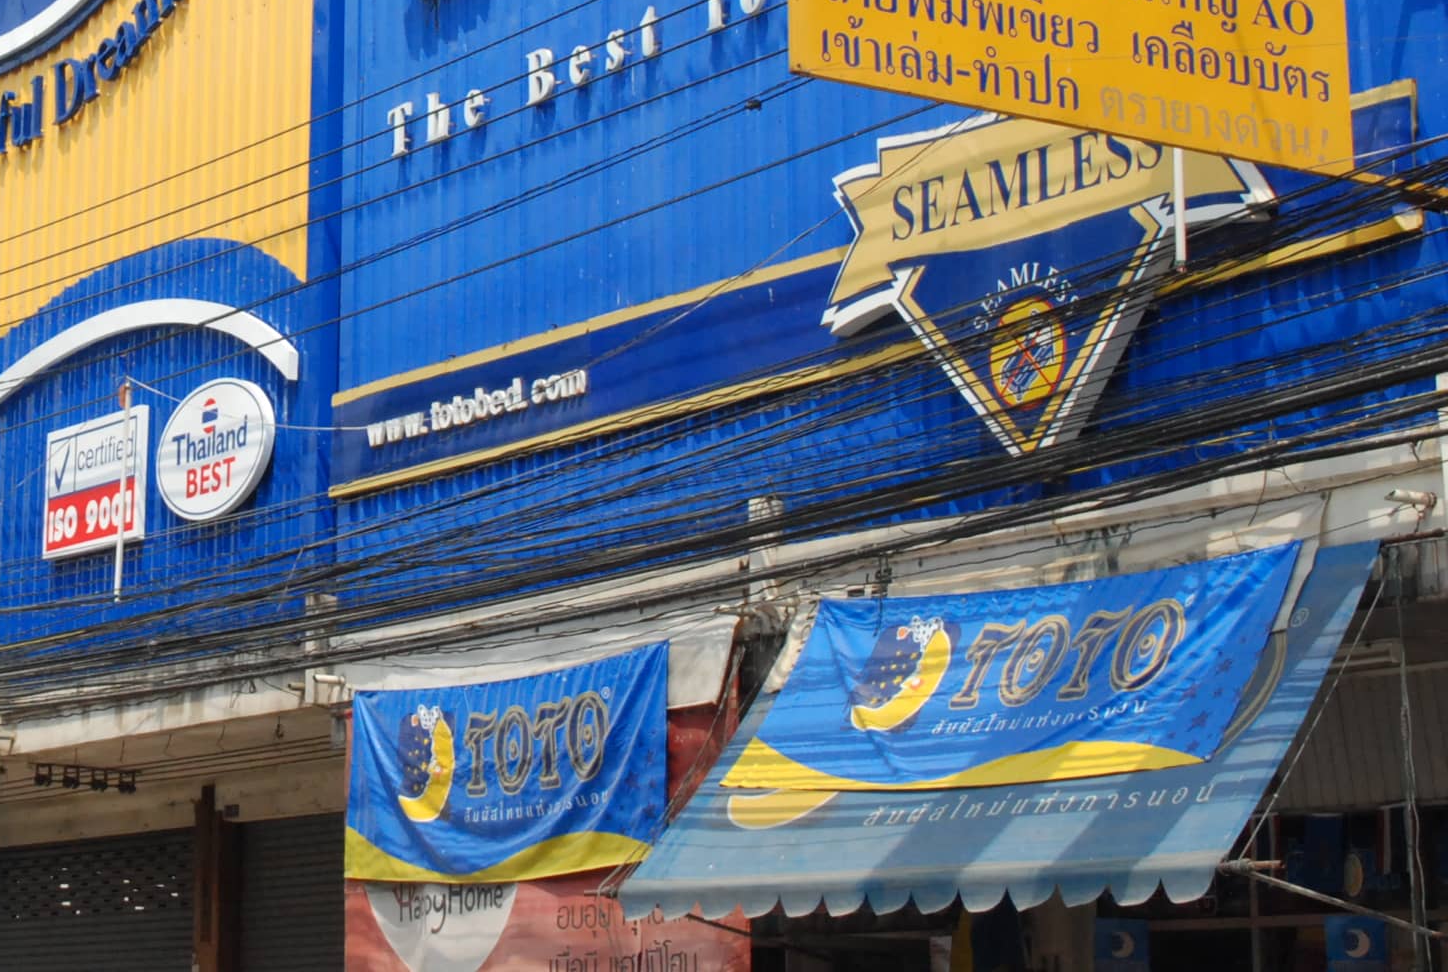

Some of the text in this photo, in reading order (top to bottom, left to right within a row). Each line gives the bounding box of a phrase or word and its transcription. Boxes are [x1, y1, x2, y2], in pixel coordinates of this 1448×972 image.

[387, 89, 486, 157] The
[526, 6, 659, 107] Best
[820, 17, 1080, 111] เข้าเล่ม-ทำปก
[1131, 22, 1330, 103] เคลือบบัตร
[77, 430, 134, 471] certified
[172, 415, 248, 466] Thailand
[185, 457, 236, 500] BEST
[47, 490, 133, 545] ISO 9001
[949, 598, 1186, 710] TOTO
[463, 691, 610, 797] TOTO
